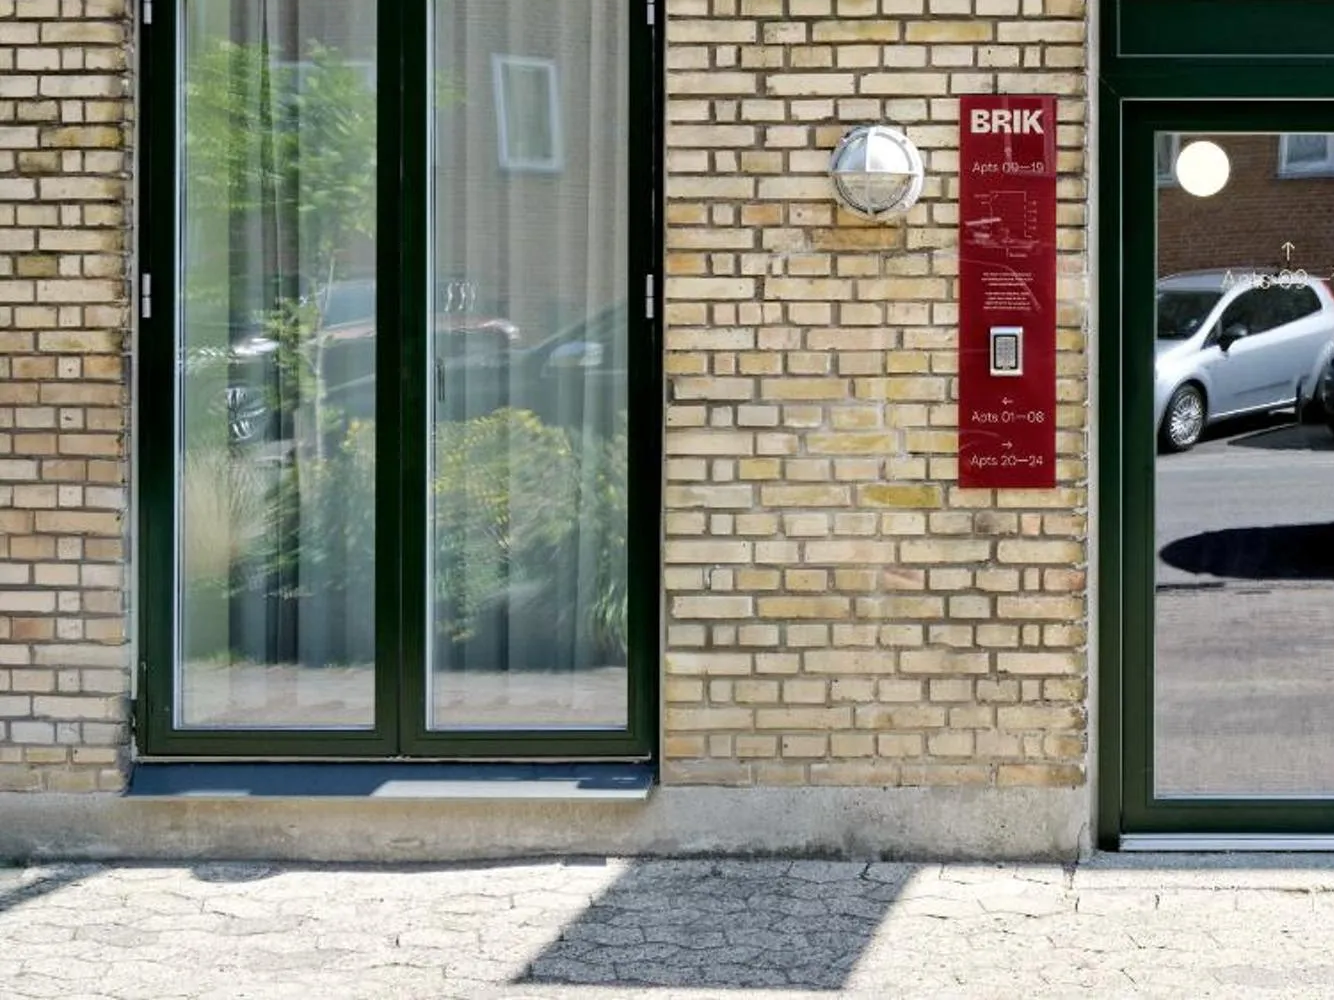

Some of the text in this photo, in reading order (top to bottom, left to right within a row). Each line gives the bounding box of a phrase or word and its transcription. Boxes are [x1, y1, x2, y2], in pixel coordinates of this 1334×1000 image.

[971, 109, 1044, 134] BRIK
[972, 161, 998, 175] Apts
[972, 411, 998, 423] Apts
[971, 454, 998, 468] Apts
